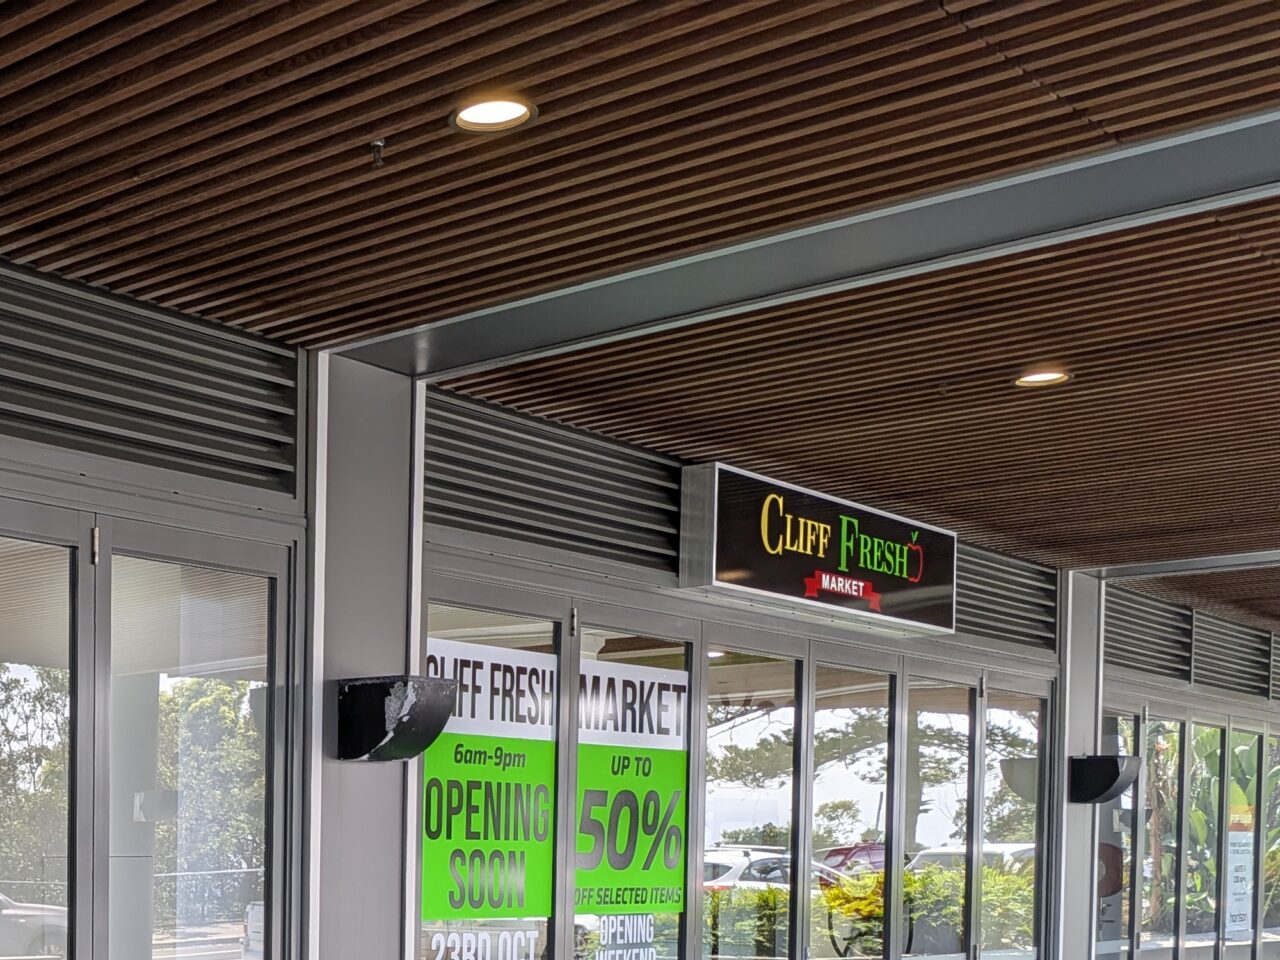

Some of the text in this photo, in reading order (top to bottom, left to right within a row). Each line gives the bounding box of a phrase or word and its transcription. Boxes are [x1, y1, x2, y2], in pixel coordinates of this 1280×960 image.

[761, 494, 909, 578] CLIFF FRESH
[821, 573, 865, 597] MARKET
[489, 662, 554, 726] FRESH
[579, 673, 687, 736] MARKET
[453, 743, 526, 771] 6am-9pm
[611, 755, 652, 777] UP TO
[425, 777, 550, 842] OPENING
[576, 789, 682, 871] 50%
[448, 848, 526, 909] SOON
[574, 886, 682, 906] OFF SELECTED ITEMS
[600, 914, 654, 945] OPENING
